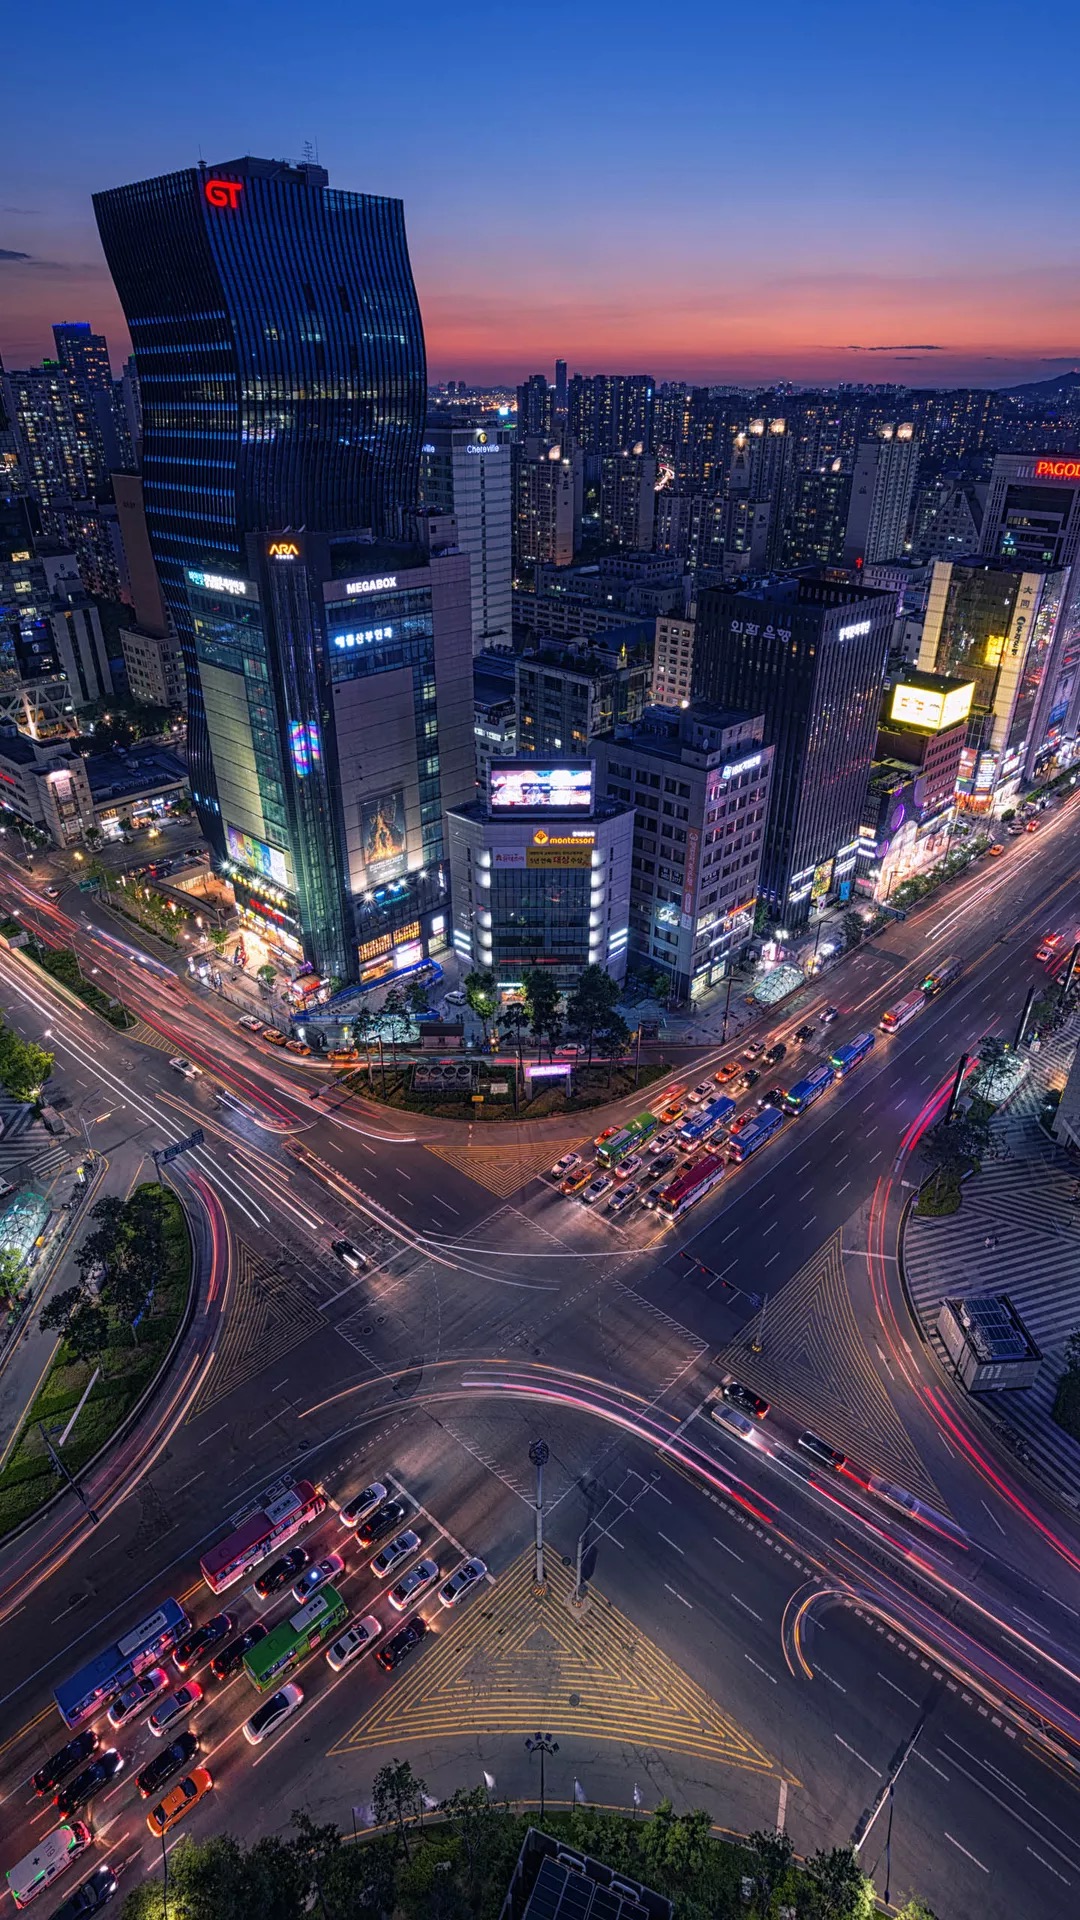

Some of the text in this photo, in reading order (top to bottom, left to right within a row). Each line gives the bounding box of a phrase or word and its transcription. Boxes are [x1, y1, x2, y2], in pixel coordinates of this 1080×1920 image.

[205, 180, 242, 208] GT
[269, 543, 299, 555] ARA
[346, 577, 397, 594] MEGABOX
[43, 1842, 56, 1858] 119
